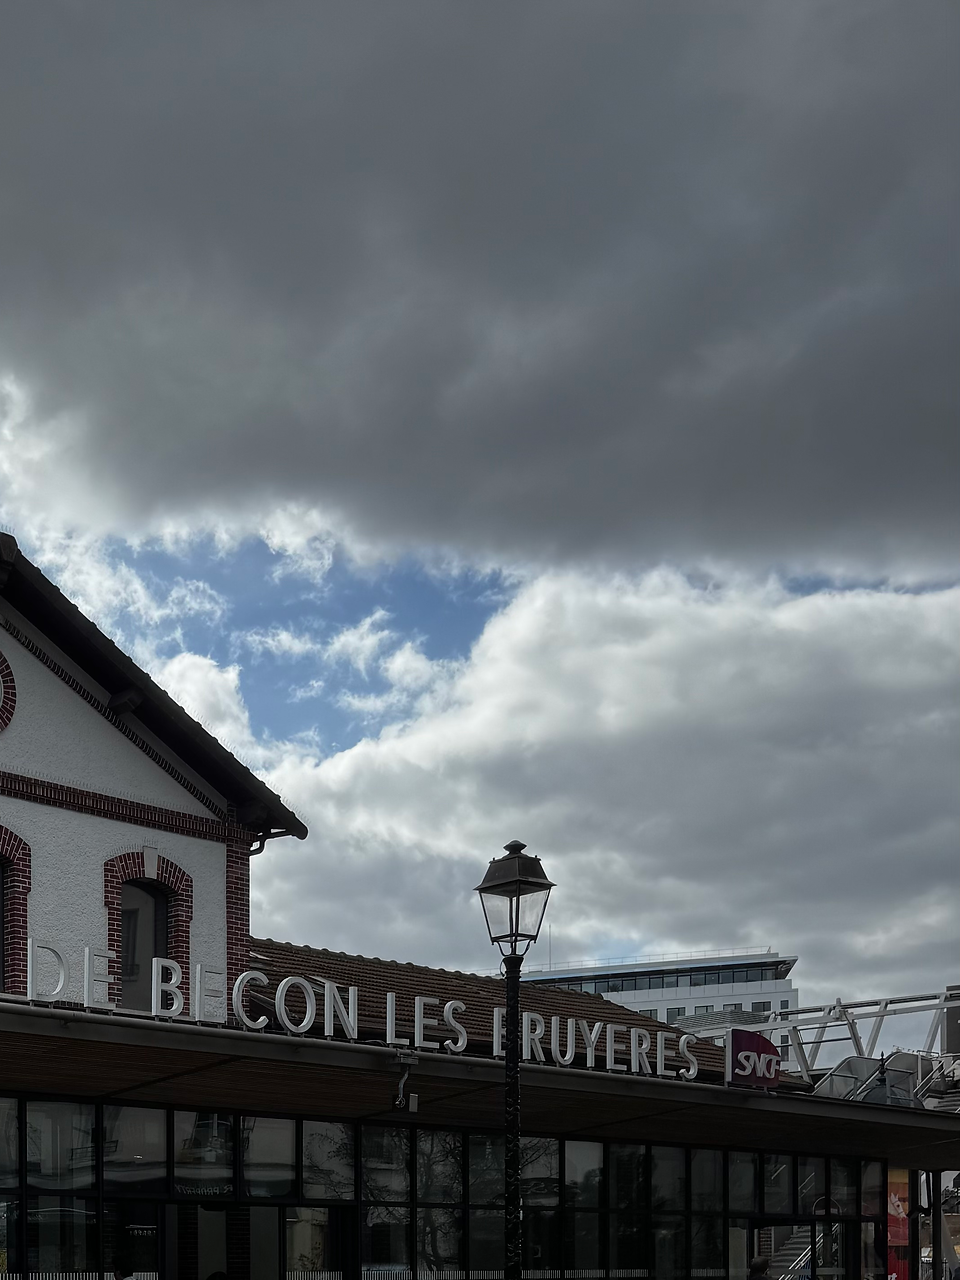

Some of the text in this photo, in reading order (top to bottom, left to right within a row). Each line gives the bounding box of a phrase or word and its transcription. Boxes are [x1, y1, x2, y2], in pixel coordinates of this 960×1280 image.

[27, 937, 116, 1009] DE
[152, 957, 358, 1039] BECON
[387, 992, 467, 1052] LES
[734, 1050, 781, 1079] SNCF
